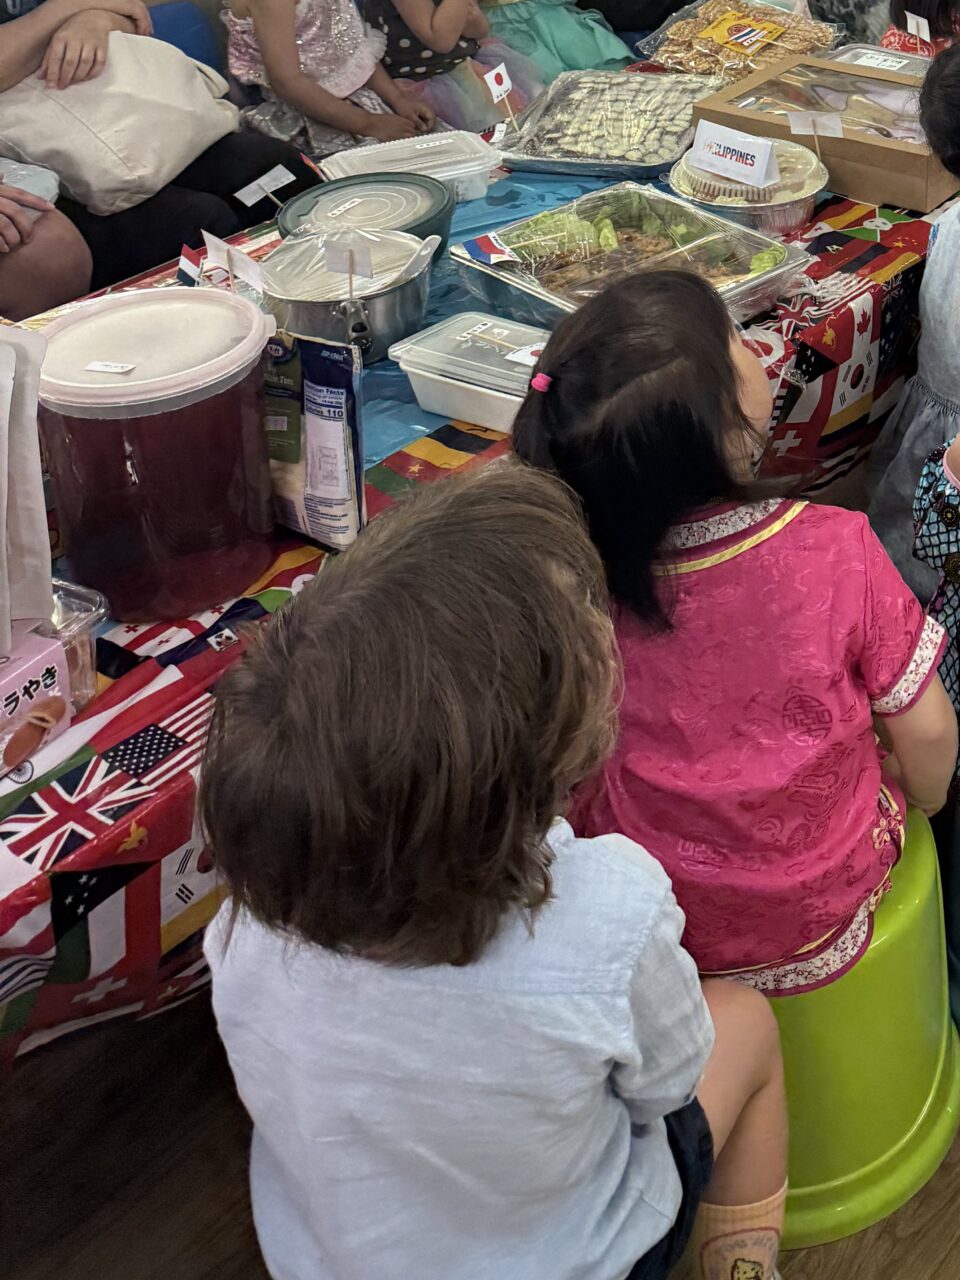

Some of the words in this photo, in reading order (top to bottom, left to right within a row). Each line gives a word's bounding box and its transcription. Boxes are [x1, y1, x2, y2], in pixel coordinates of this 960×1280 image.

[327, 409, 344, 418] 110
[0, 663, 58, 716] ラやき
